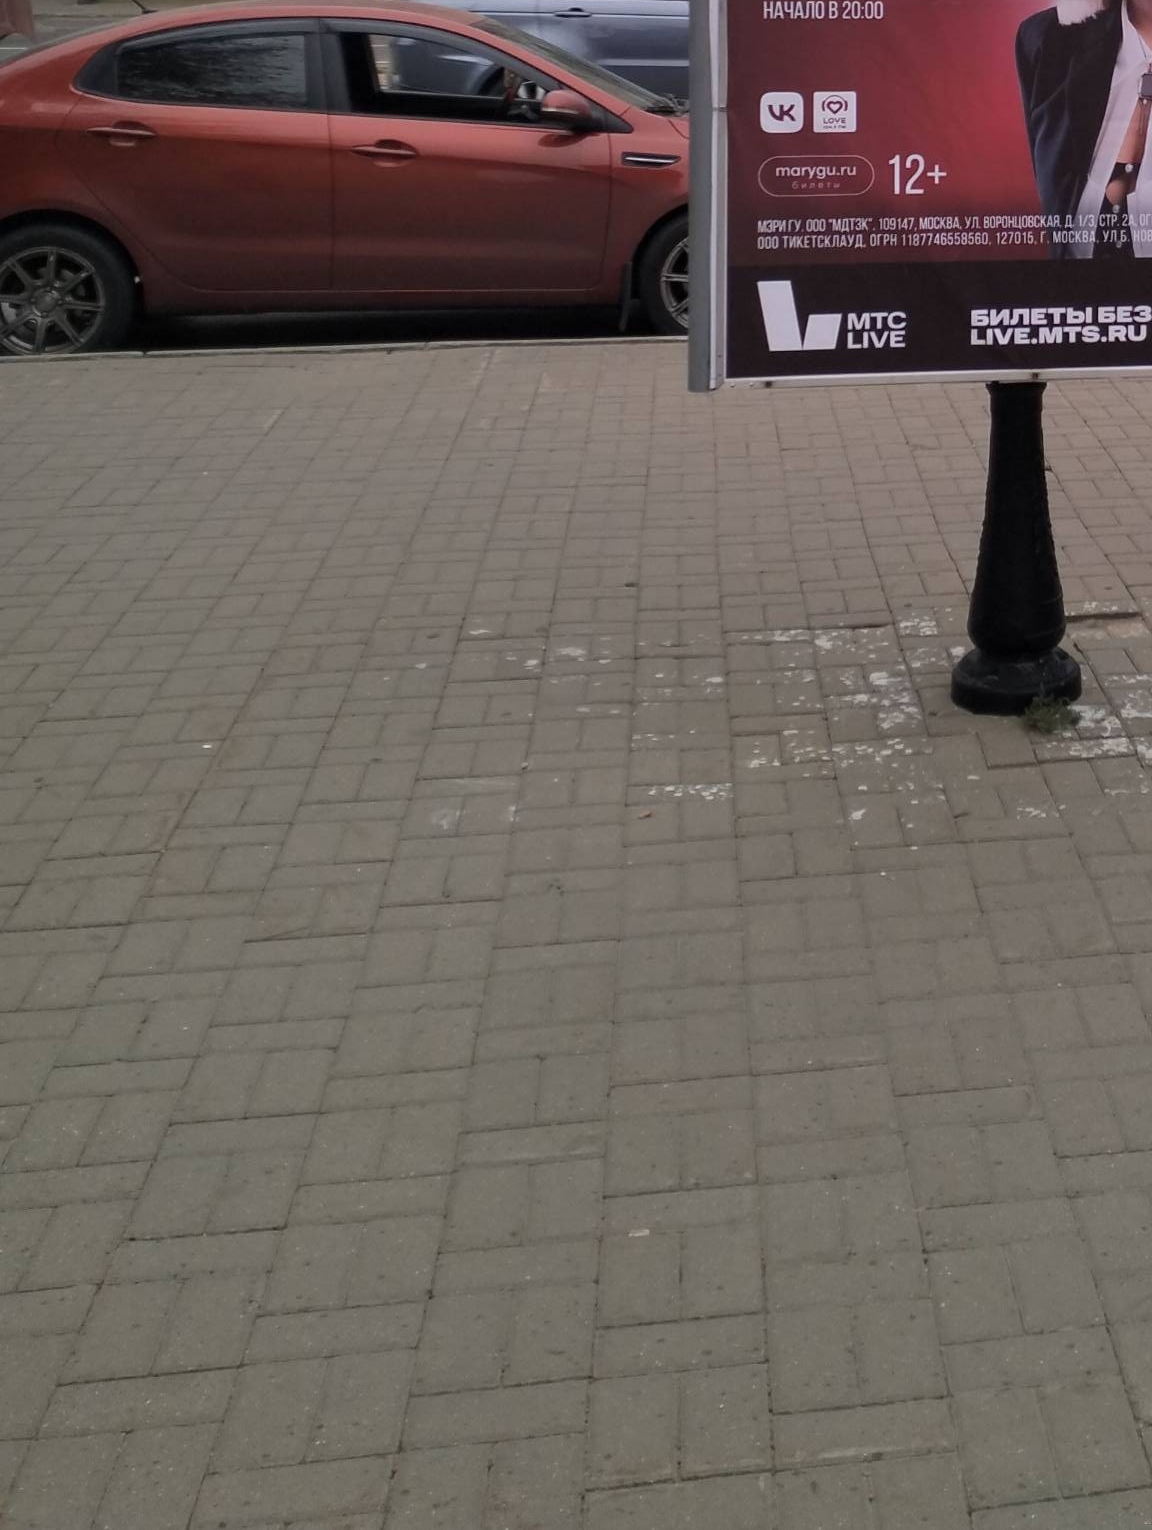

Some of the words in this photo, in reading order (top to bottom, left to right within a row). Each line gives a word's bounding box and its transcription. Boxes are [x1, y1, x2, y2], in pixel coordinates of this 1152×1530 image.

[762, 1, 825, 21] НАЧАЛО
[828, 1, 838, 20] В
[841, 0, 884, 20] 20:00
[823, 117, 847, 125] LOVE
[775, 165, 857, 179] marygu.ru
[888, 153, 947, 195] 12+
[757, 220, 786, 233] МЭРИ
[806, 219, 826, 232] ООО
[757, 236, 779, 250] ООО
[869, 233, 897, 247] ОГРН
[847, 311, 907, 330] МТС
[971, 306, 1094, 327] БИЛЕТЫ
[1098, 305, 1152, 325] БЕЗ
[847, 330, 906, 349] LIVE
[971, 324, 1148, 346] LIVE.MTS.RU
